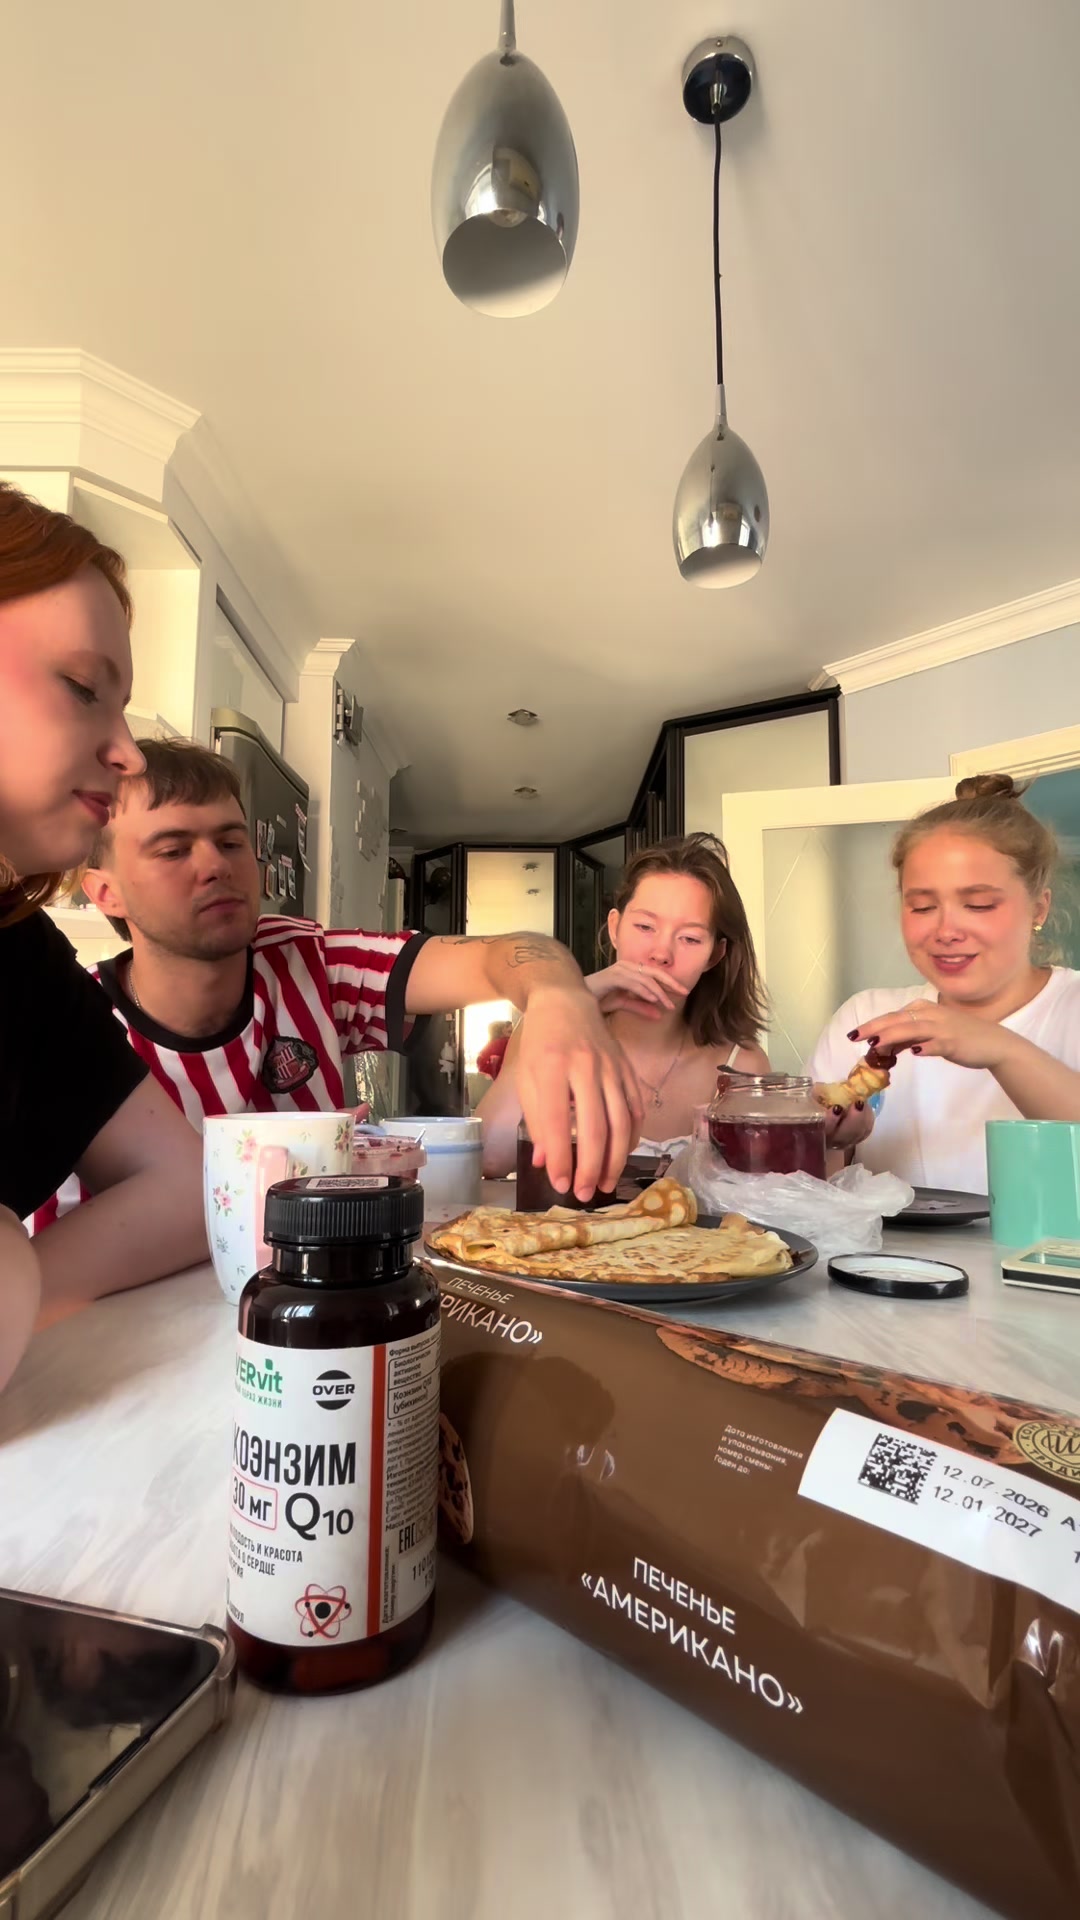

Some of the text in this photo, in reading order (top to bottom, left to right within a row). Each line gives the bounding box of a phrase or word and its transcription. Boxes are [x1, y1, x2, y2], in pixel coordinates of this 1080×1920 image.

[447, 1277, 514, 1304] ПЕЧЕНЬЕ
[440, 1293, 543, 1344] РИКАНО»
[257, 1395, 282, 1408] ЖИЗНИ
[312, 1383, 355, 1397] OVER
[233, 1422, 356, 1487] КОЭНЗИМ
[717, 1445, 773, 1472] номер смены:
[724, 1424, 804, 1459] Дата изготовления
[727, 1438, 787, 1466] упаковывания,
[714, 1454, 737, 1469] Годен
[233, 1476, 245, 1510] 30
[943, 1465, 1050, 1518] 12.07.2026
[285, 1492, 354, 1541] Q10
[934, 1486, 1043, 1537] 12.01.2027
[247, 1554, 275, 1576] СЕРДЦЕ
[256, 1543, 262, 1555] И
[264, 1545, 303, 1563] КРАСОТА
[633, 1556, 736, 1635] ПЕЧЕНЬЕ
[581, 1572, 804, 1714] «АМЕРИКАНО»
